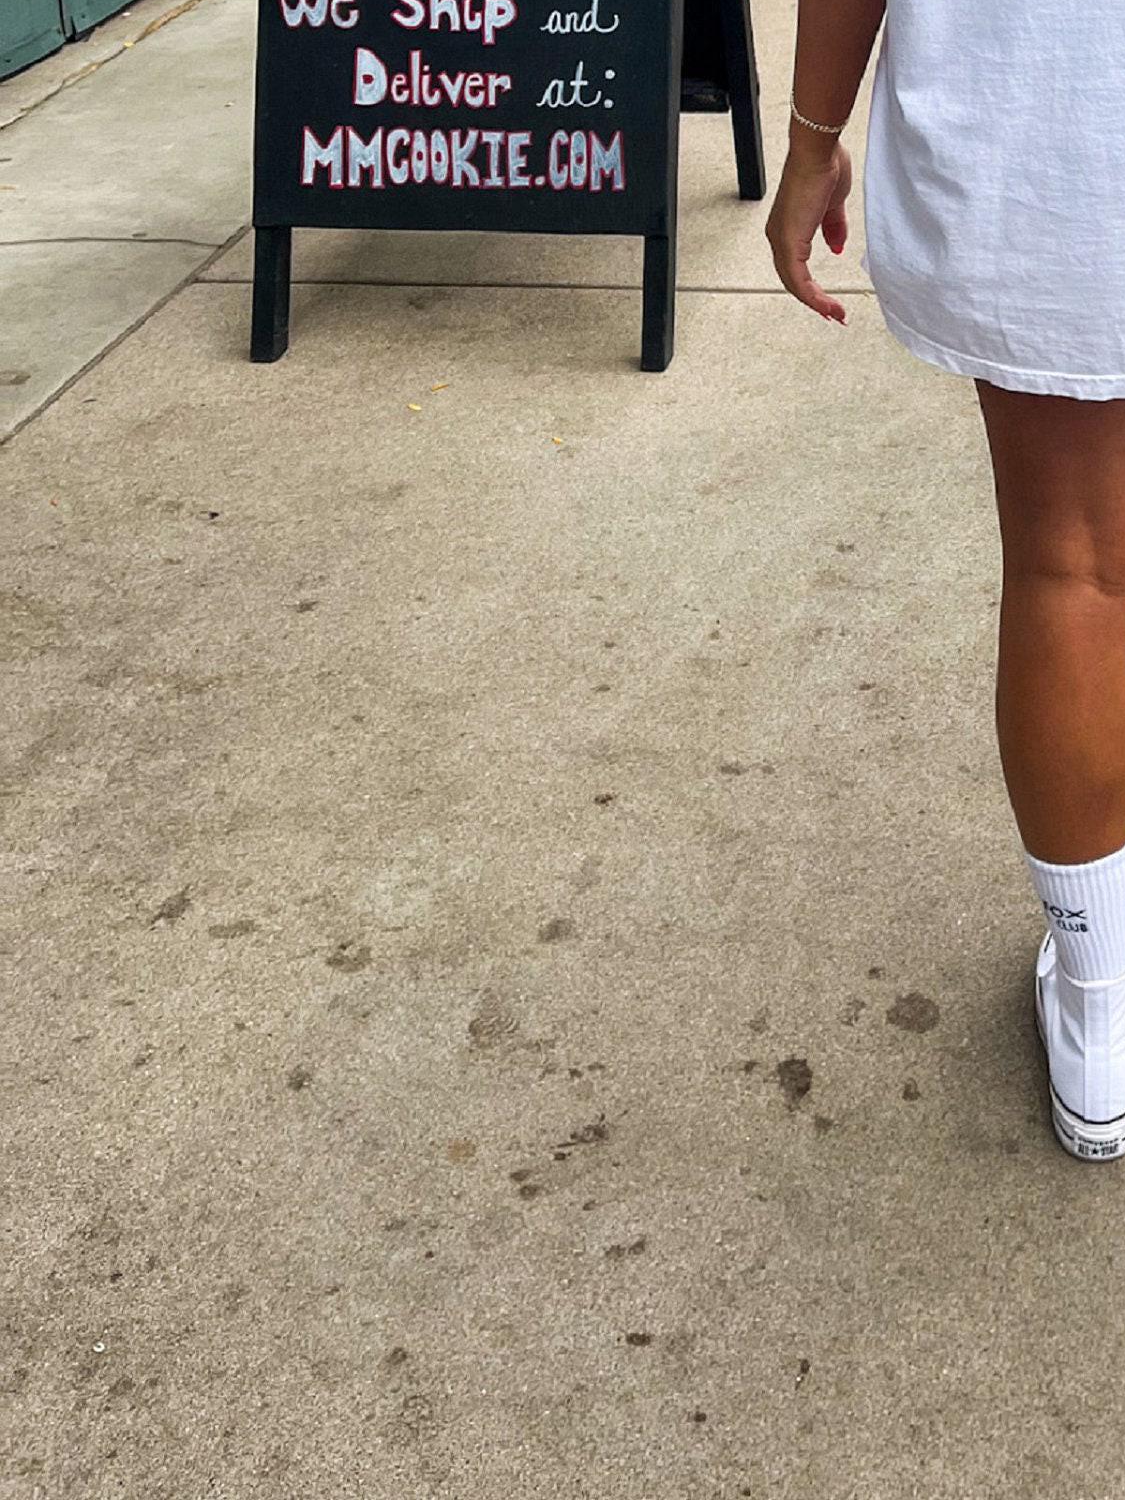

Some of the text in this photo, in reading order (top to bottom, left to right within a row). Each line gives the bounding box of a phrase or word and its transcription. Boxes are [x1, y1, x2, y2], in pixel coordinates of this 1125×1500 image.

[353, 47, 512, 109] Deliver
[300, 125, 627, 192] MMCOOKIE.COM
[1043, 900, 1087, 919] OX
